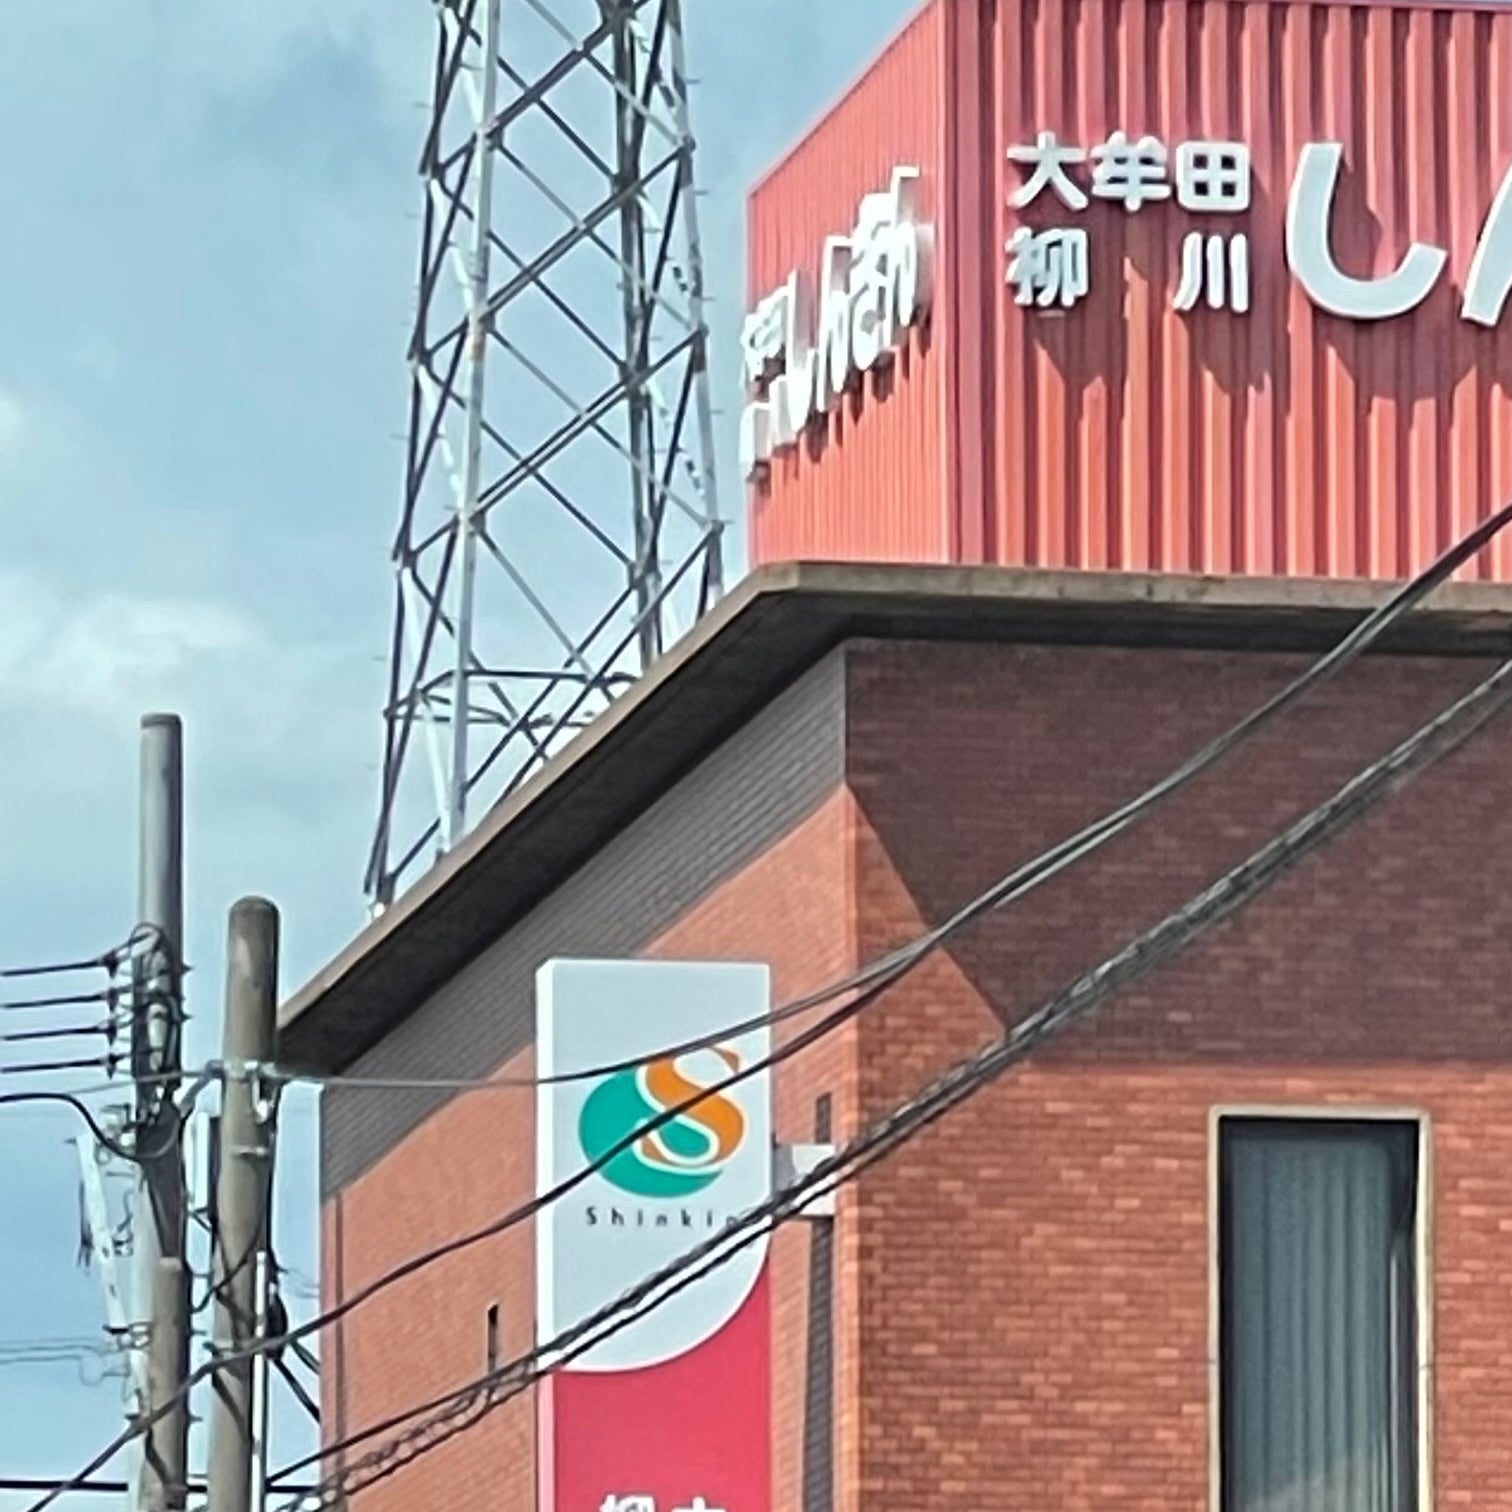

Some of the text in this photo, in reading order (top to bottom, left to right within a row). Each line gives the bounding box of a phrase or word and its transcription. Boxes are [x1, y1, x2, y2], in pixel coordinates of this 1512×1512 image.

[1006, 131, 1252, 214] 大牟田
[1004, 225, 1251, 314] 柳川
